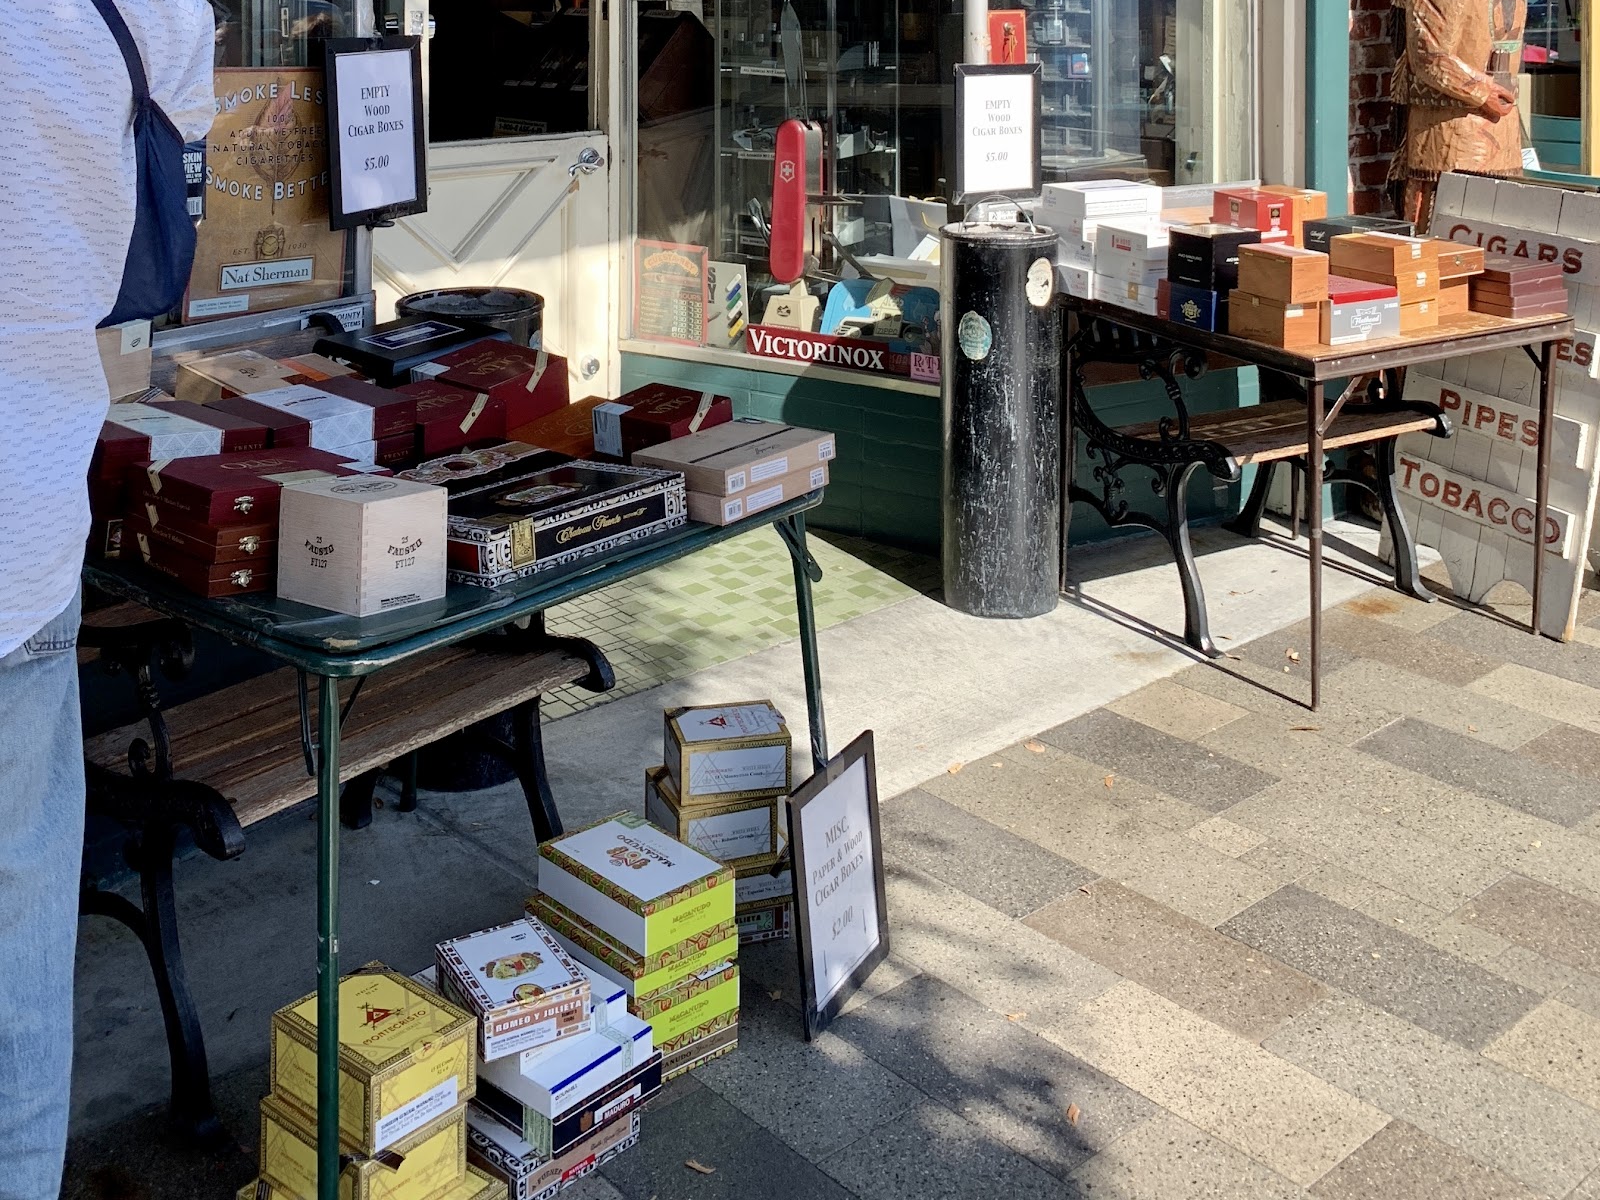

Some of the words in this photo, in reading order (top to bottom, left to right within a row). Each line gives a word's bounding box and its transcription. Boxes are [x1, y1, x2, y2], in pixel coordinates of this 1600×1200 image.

[361, 85, 390, 100] EMPTY
[364, 104, 390, 117] WOOD
[985, 99, 1011, 110] EMPTY
[988, 113, 1011, 122] WOOD
[348, 123, 375, 138] CIGAR
[377, 119, 404, 132] BOXES
[972, 126, 996, 137] CIGAR
[999, 124, 1023, 135] BOXES
[213, 141, 271, 153] NATURAL
[985, 151, 1008, 163] $5.00
[182, 151, 202, 164] SKIN
[236, 153, 314, 166] CIGARETTES
[364, 154, 389, 171] $5.00
[273, 173, 328, 201] BETTE
[1448, 222, 1584, 275] CIGARS
[224, 268, 250, 285] Nat
[252, 265, 309, 283] Sherman
[877, 327, 898, 335] ZIPPO
[749, 327, 884, 371] VICTORINOX
[1439, 387, 1540, 448] PIPES
[1400, 456, 1560, 545] TOBACCO
[304, 539, 335, 556] FAUSTO
[387, 538, 423, 556] FAUSTO
[310, 557, 328, 569] FT127
[395, 556, 415, 569] FT127
[824, 815, 850, 848] MISC.
[617, 834, 675, 868] MACANUDO
[812, 855, 836, 886] PAPER
[843, 830, 863, 856] WOOD
[814, 877, 840, 907] CIGAR
[840, 851, 864, 883] BOXES
[672, 901, 711, 924] MACANUDO
[831, 905, 853, 941] $2.00
[667, 950, 707, 973] MACANUDO
[495, 1015, 531, 1033] ROMEO
[533, 1012, 540, 1021] Y
[543, 999, 582, 1019] JULIETA
[668, 999, 709, 1023] MACANUDO
[362, 1009, 426, 1046] MONTECRISTO
[604, 1098, 631, 1120] MADURO
